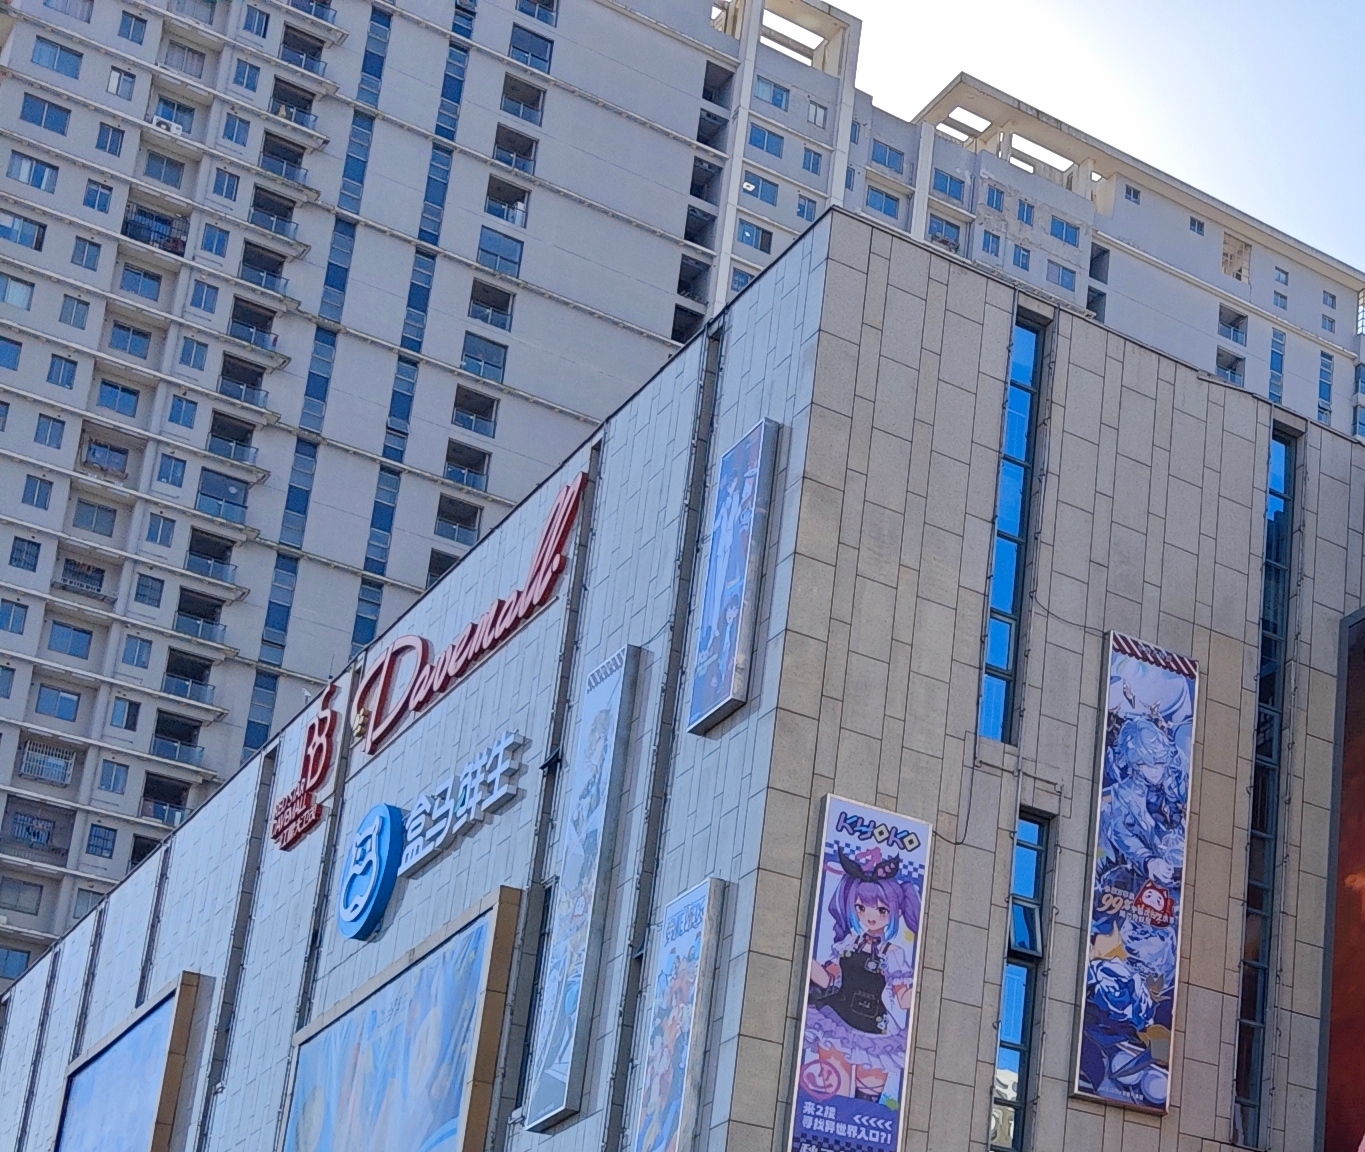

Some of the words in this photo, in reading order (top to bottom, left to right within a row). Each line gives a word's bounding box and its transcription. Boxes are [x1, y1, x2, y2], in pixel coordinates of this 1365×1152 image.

[397, 730, 520, 878] 盒马鲜生
[836, 811, 921, 852] KYOKO
